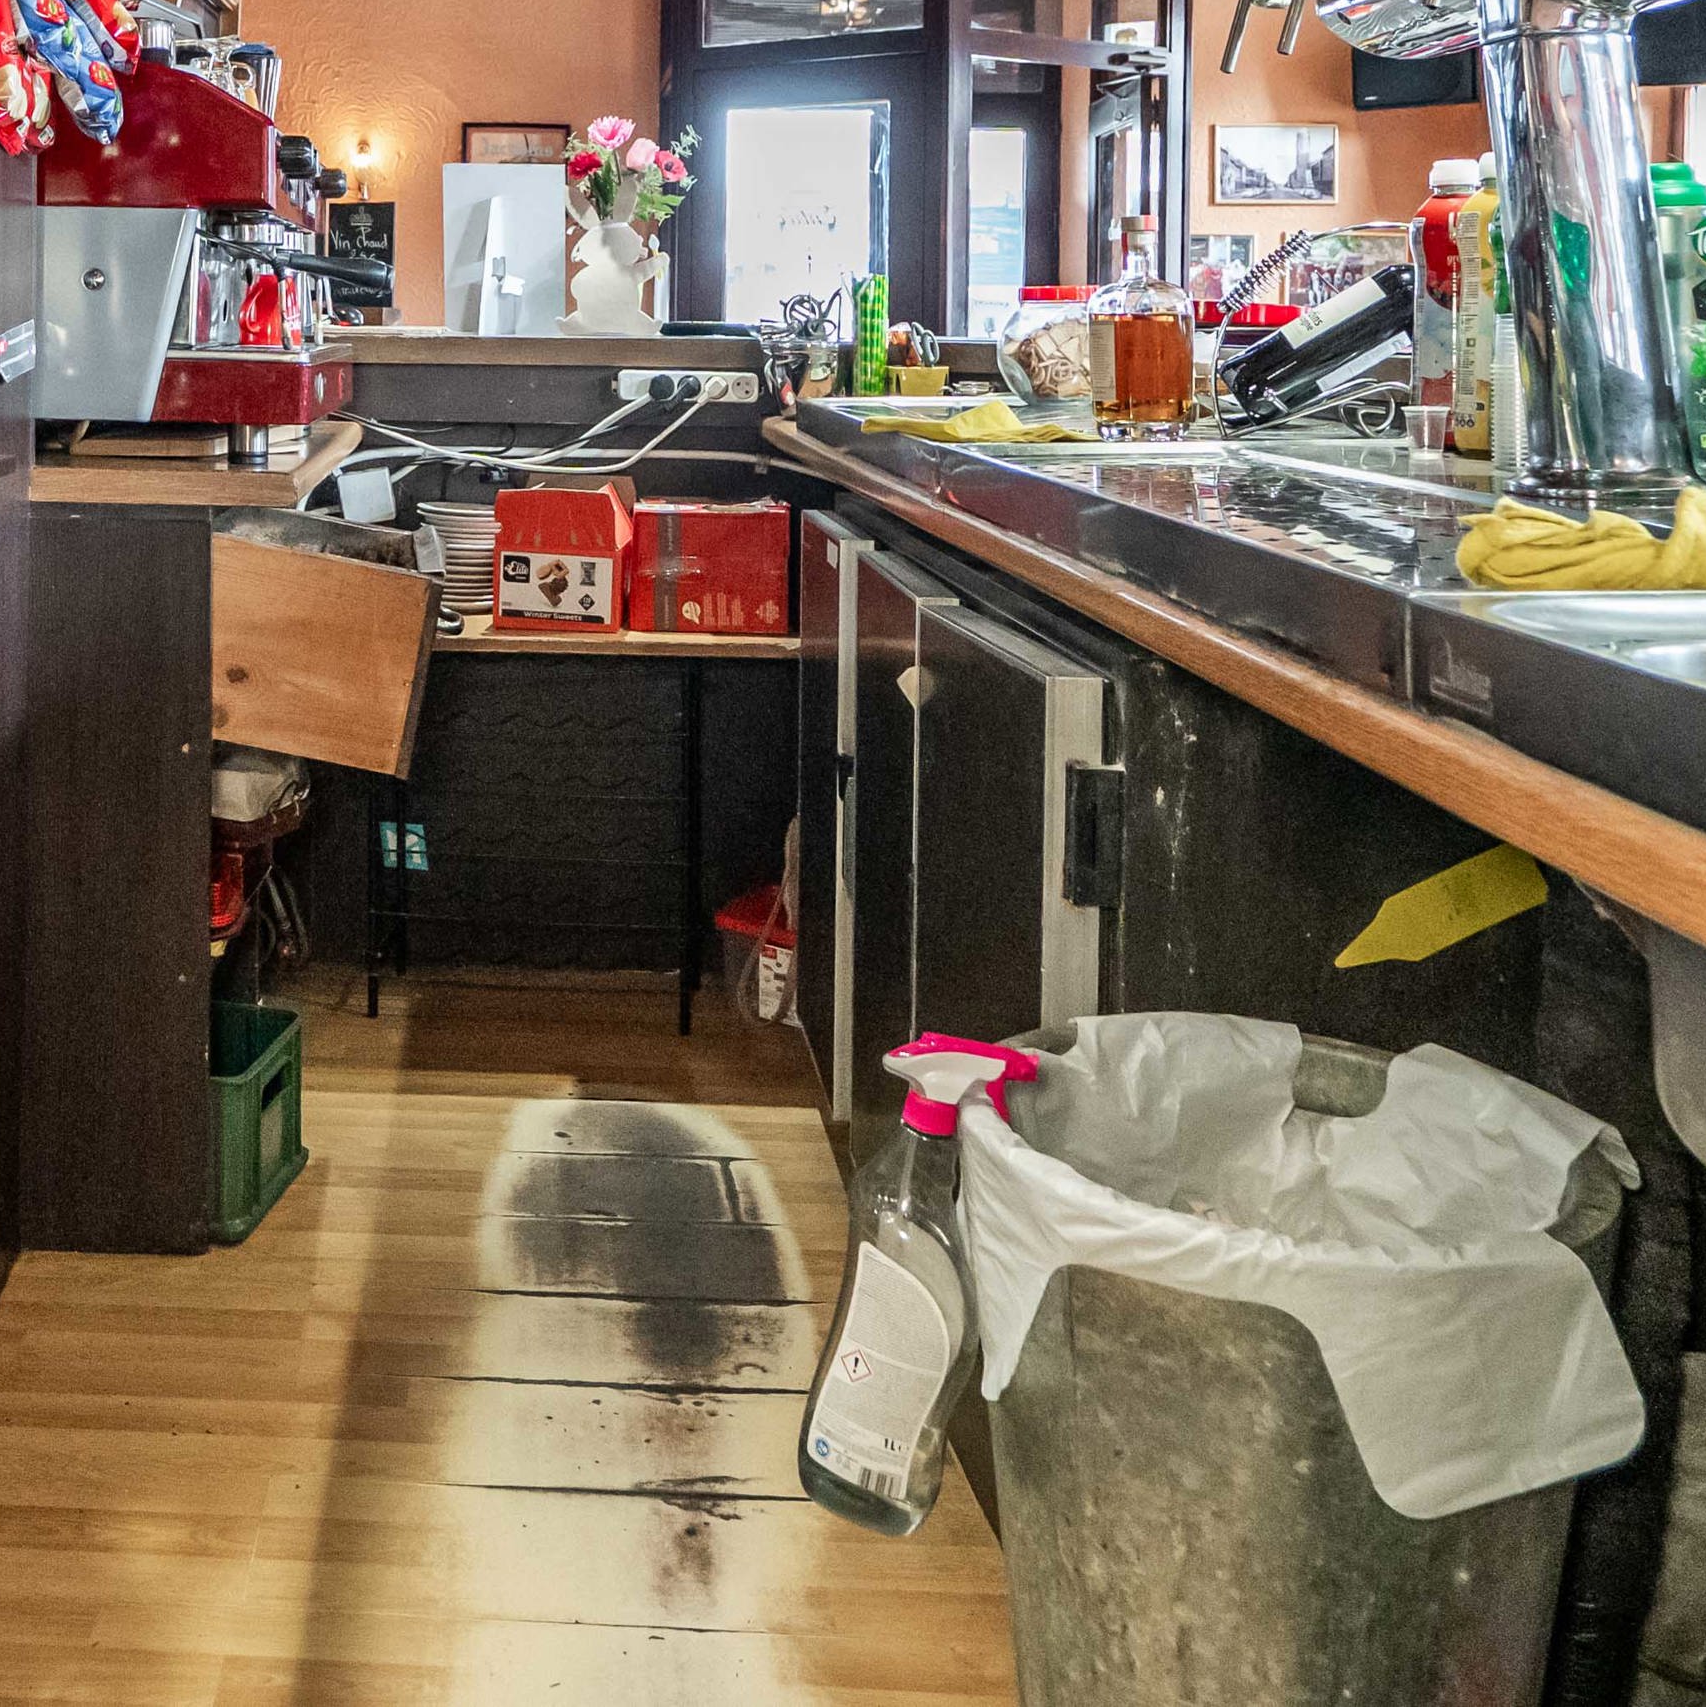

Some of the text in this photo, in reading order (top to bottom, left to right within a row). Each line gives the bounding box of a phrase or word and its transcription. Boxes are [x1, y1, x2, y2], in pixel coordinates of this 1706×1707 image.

[330, 230, 351, 250] Vin
[523, 611, 583, 622] Winter Sweets
